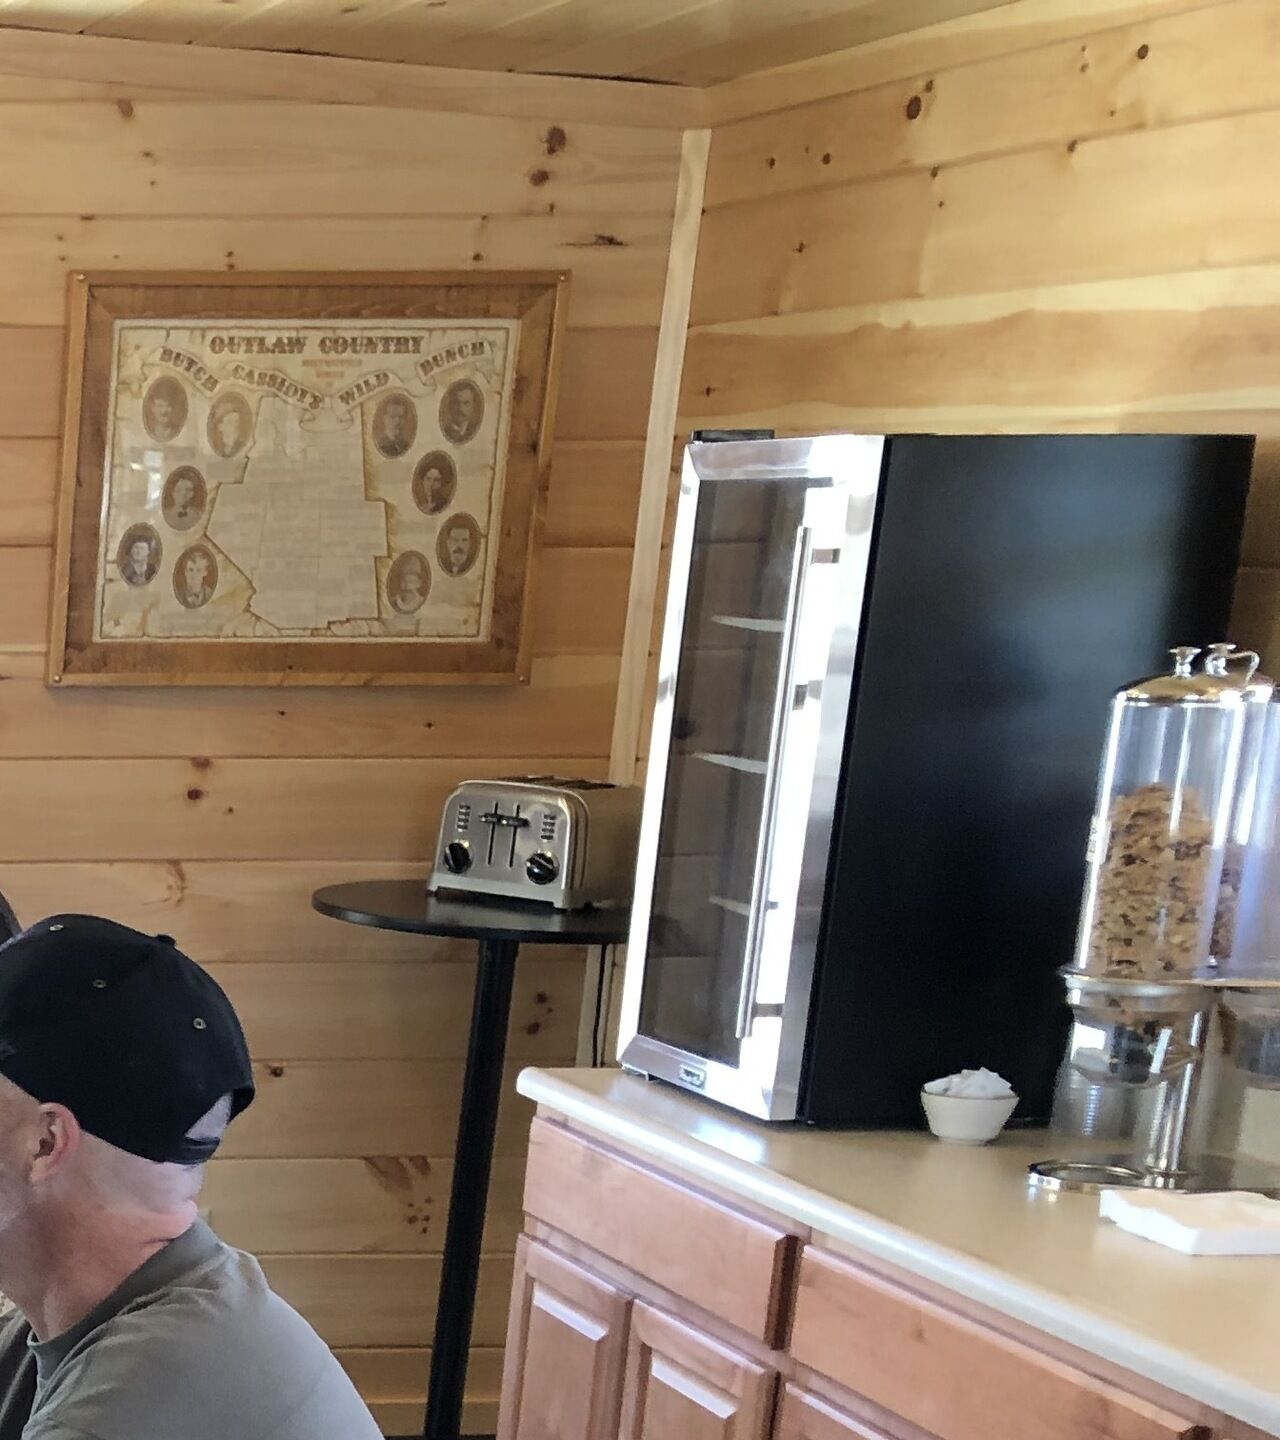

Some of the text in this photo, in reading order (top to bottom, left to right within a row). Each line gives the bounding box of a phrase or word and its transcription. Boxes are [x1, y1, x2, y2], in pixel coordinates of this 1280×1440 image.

[209, 336, 425, 354] OUTLAW COUNTRY
[159, 347, 220, 393] BUTCH
[339, 371, 390, 406] WILD
